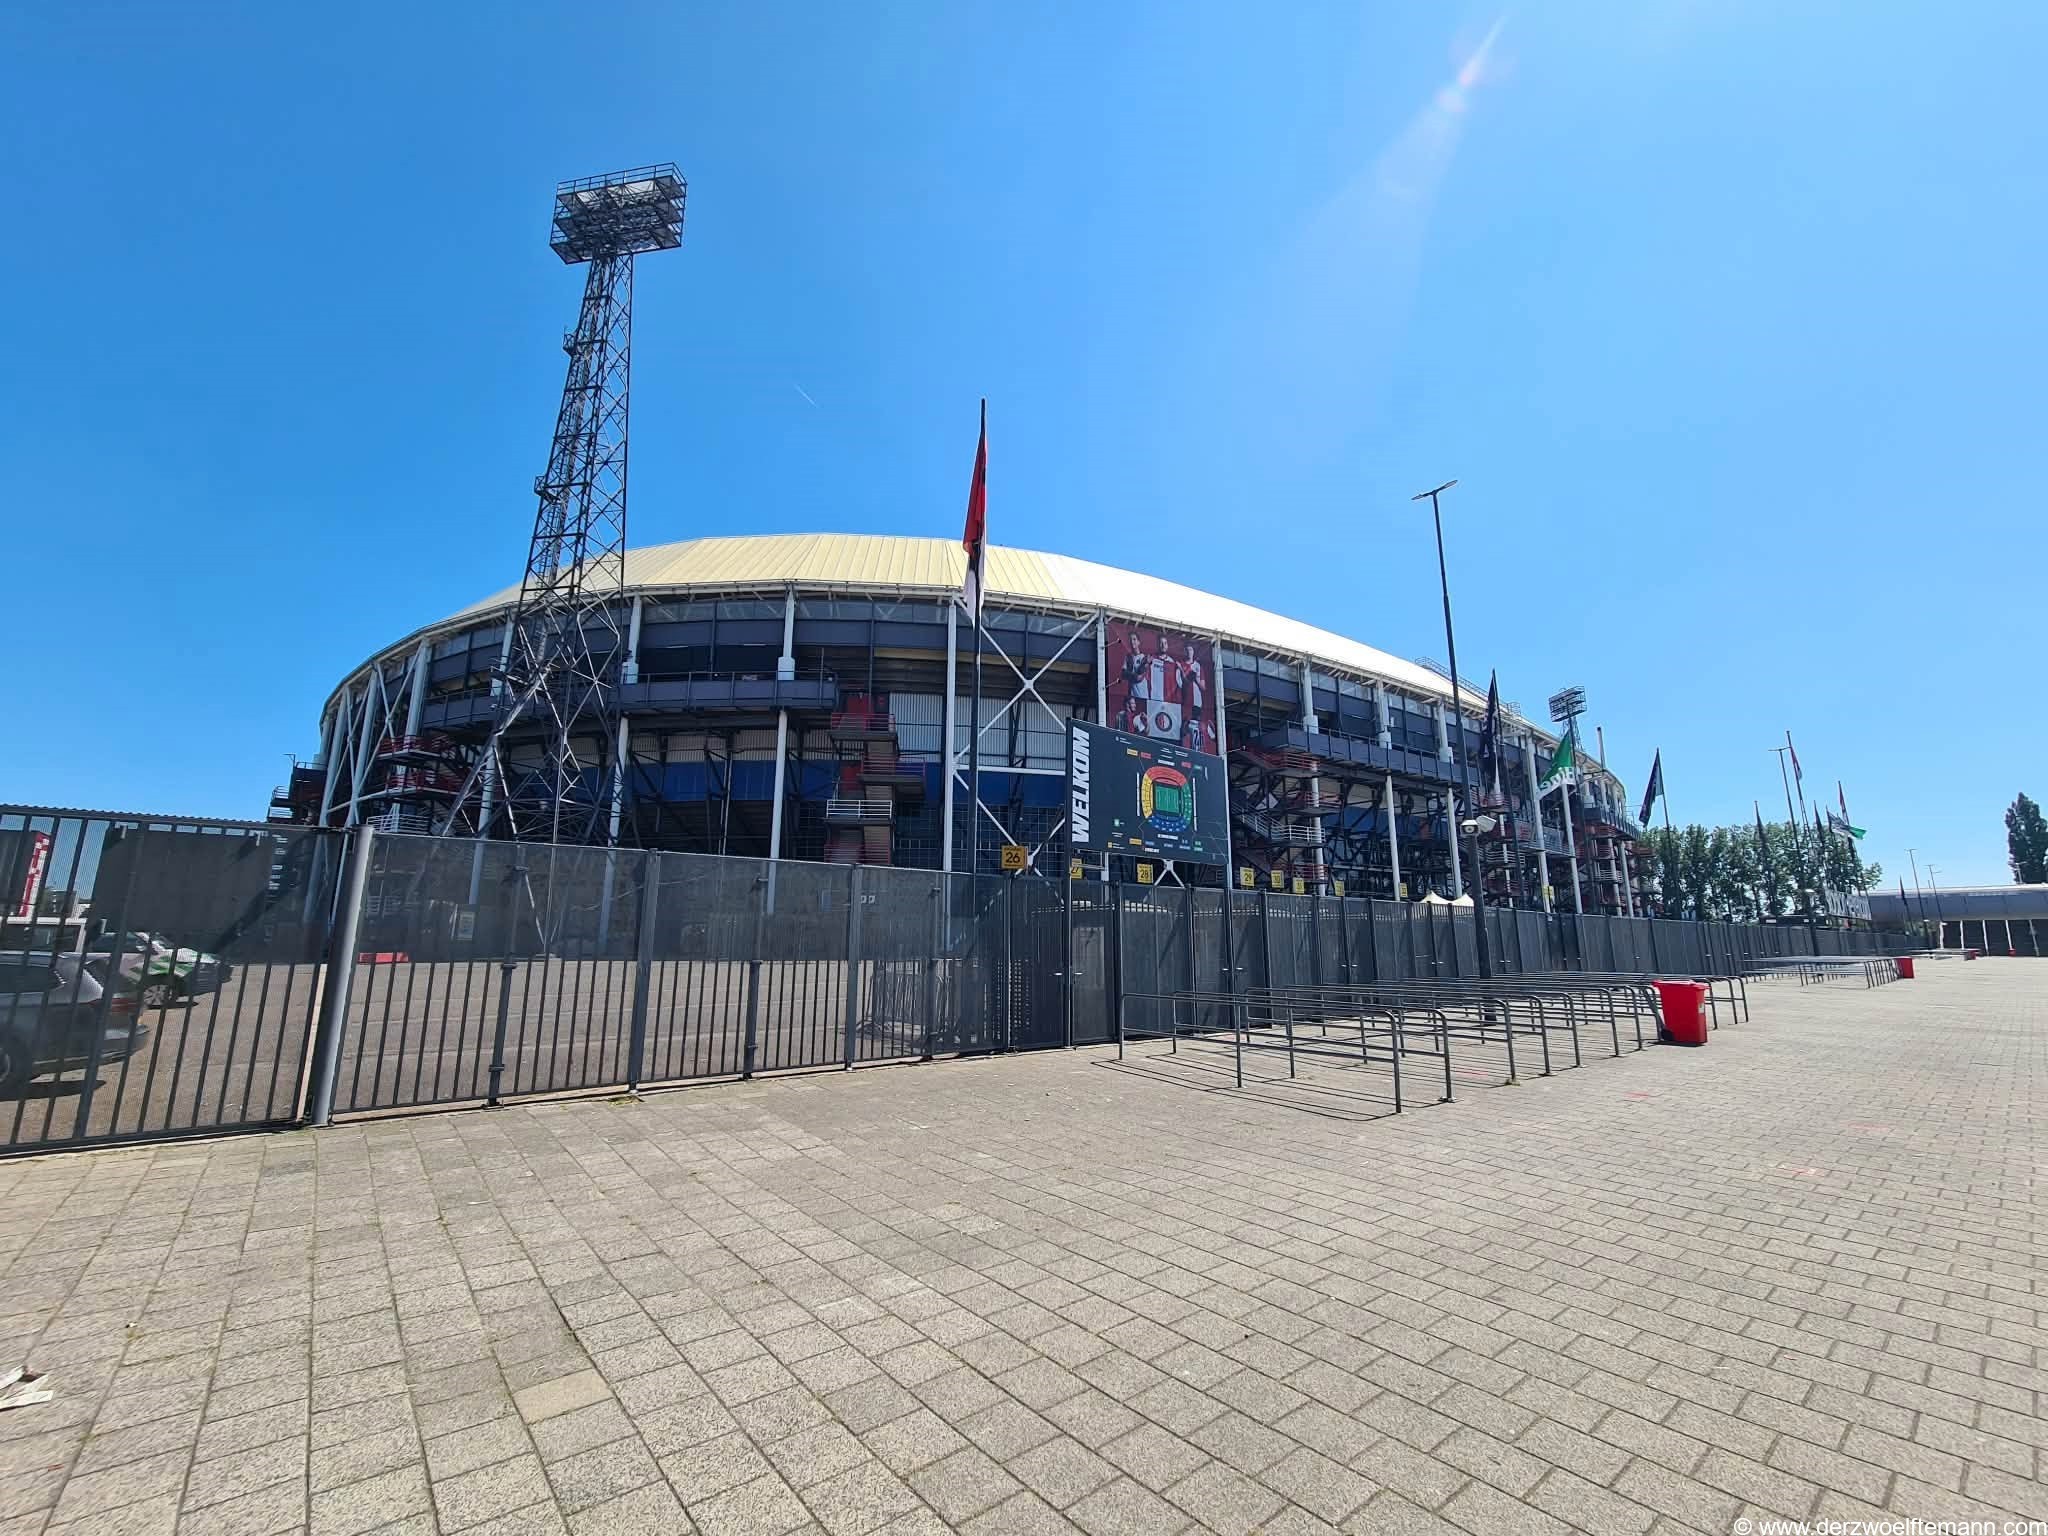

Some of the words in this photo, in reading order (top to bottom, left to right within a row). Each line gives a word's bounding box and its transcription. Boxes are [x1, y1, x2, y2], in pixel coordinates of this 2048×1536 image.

[1071, 726, 1090, 843] WELKOM
[1006, 852, 1020, 863] 26
[1140, 869, 1149, 879] 28
[1244, 873, 1252, 881] 29
